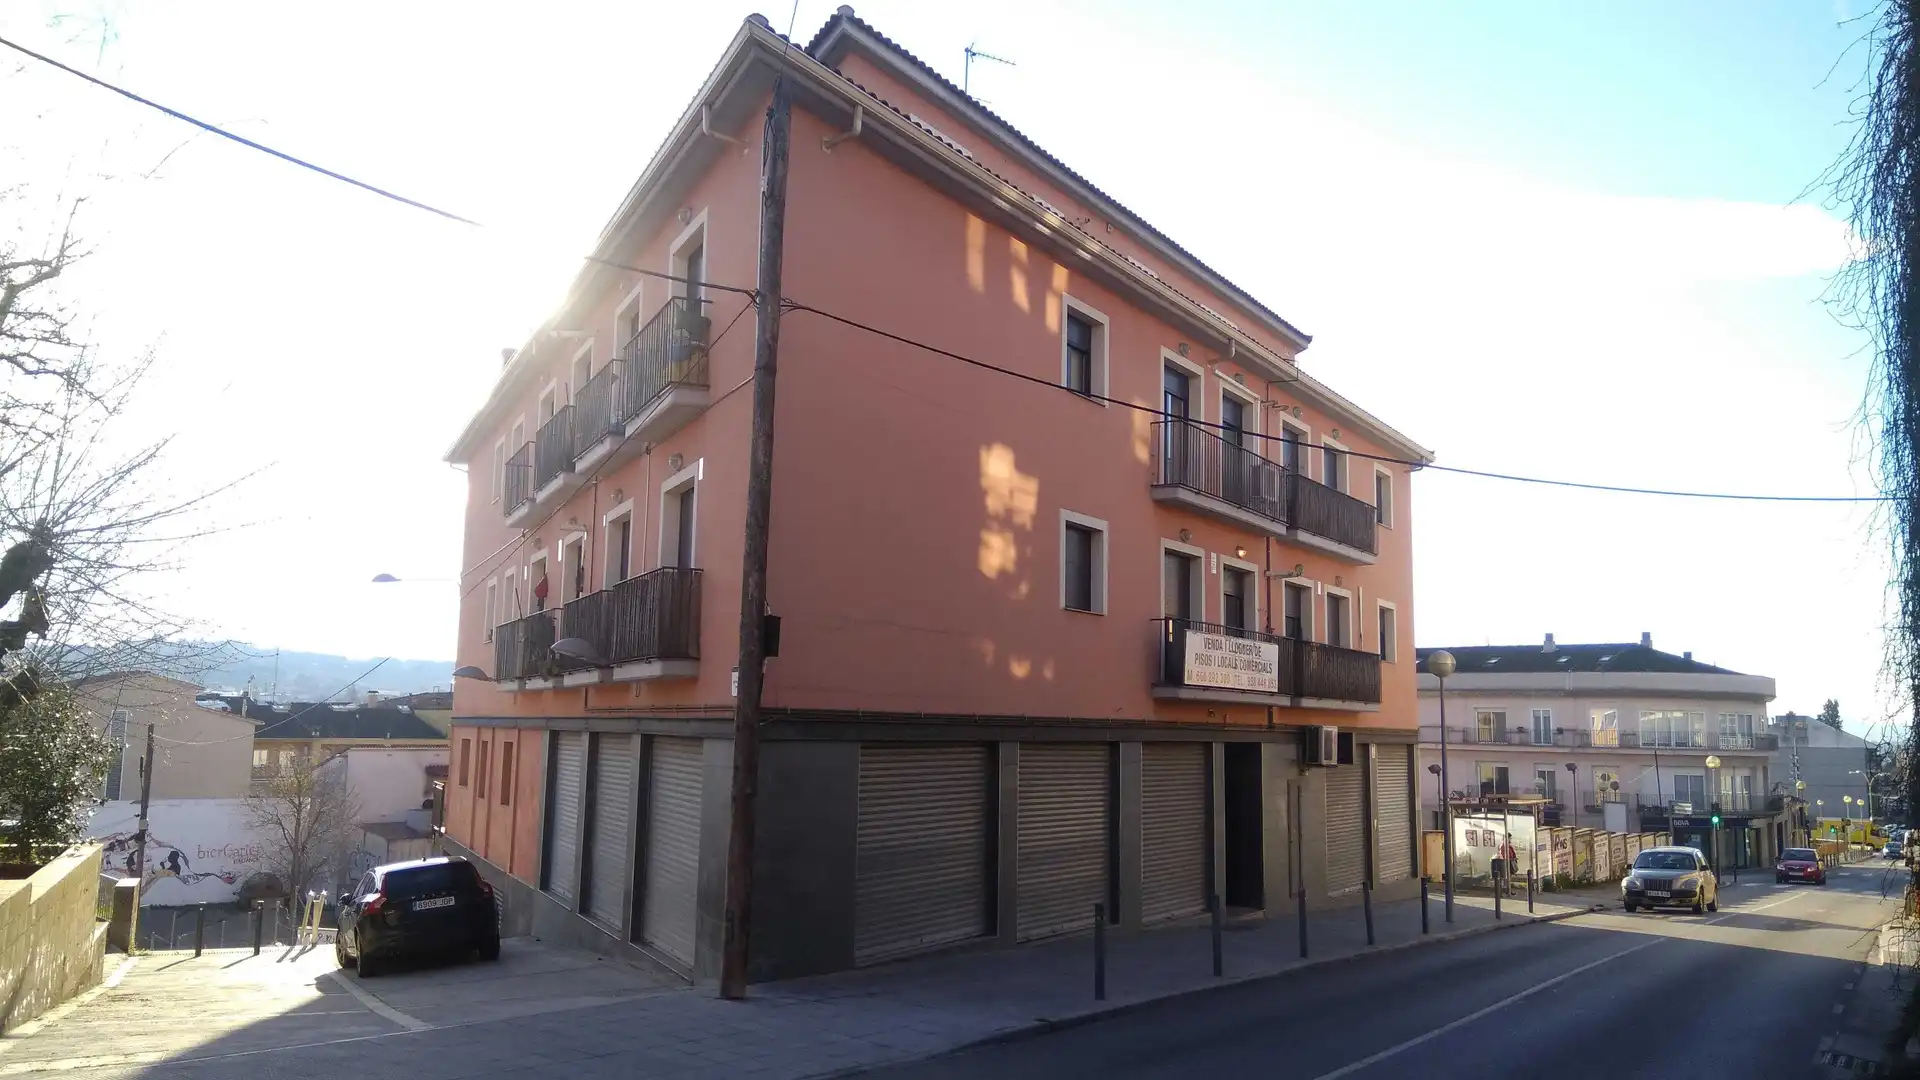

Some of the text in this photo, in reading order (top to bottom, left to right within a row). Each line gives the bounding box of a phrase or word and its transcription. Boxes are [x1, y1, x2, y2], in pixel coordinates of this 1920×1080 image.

[1203, 637, 1223, 652] VENDA
[1254, 643, 1262, 658] DE
[1194, 652, 1212, 667] PISOS
[1217, 656, 1238, 670] LOCALS
[1239, 658, 1273, 675] COMERCIALS
